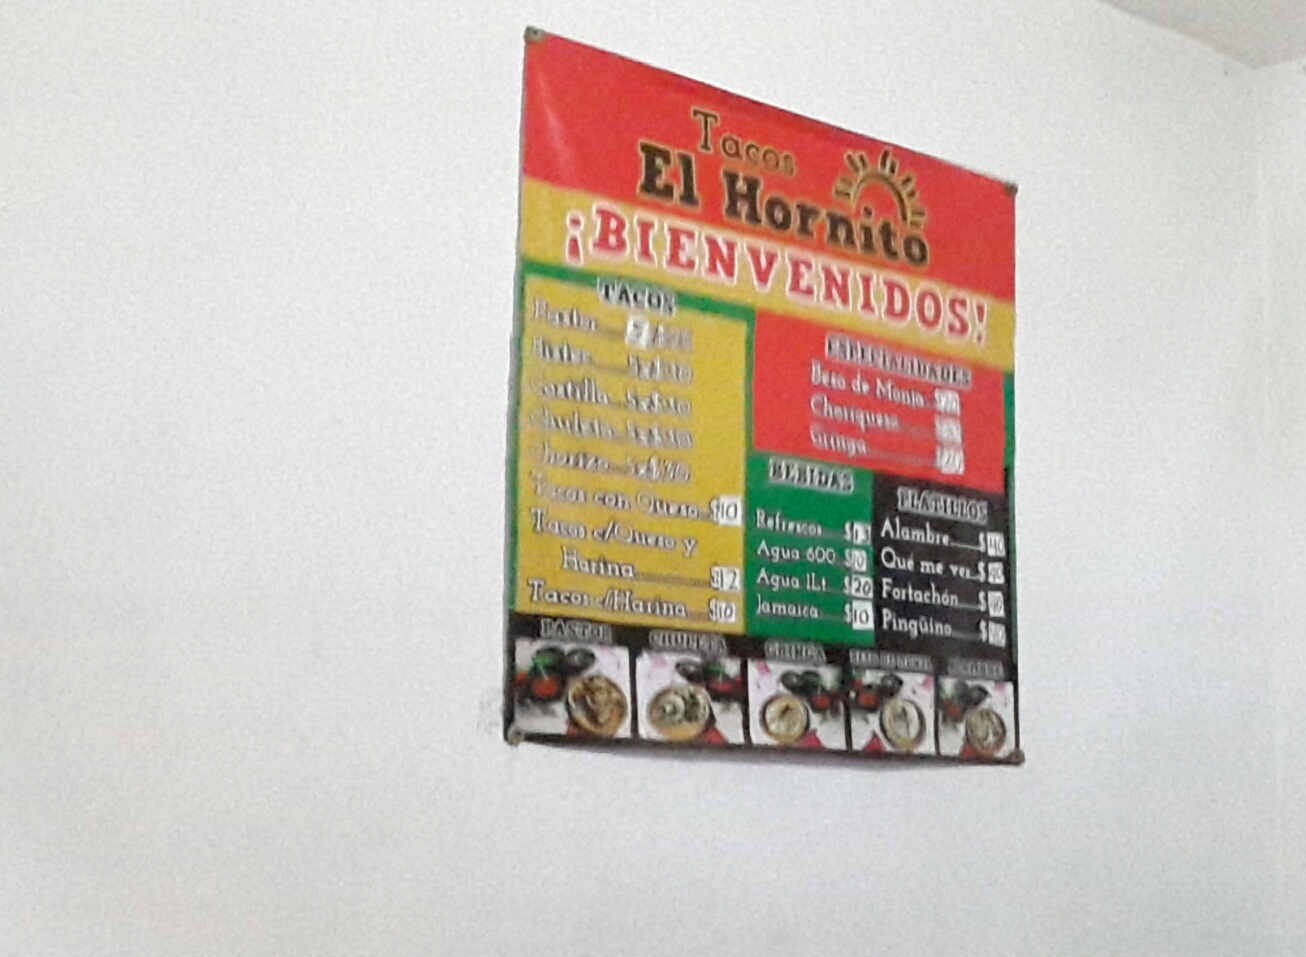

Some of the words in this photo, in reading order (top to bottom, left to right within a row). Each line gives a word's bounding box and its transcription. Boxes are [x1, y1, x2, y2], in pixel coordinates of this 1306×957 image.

[692, 107, 796, 175] Tacos
[638, 142, 700, 208] El
[721, 167, 930, 266] Hornito
[565, 203, 988, 346] ¡BIENVENIDOS!
[598, 279, 676, 316] TACOS
[852, 369, 870, 395] de
[530, 470, 587, 502] Tacos
[594, 492, 631, 510] con
[637, 492, 700, 518] Queso
[530, 508, 587, 539] Tacos
[683, 538, 698, 558] y
[756, 508, 823, 537] Refrescos
[881, 516, 950, 546] Alambre
[561, 546, 636, 578] Harina
[757, 540, 800, 563] Agua
[806, 549, 836, 564] 600
[881, 547, 915, 569] Qué
[920, 558, 943, 575] me
[528, 579, 591, 606] Tacos
[757, 568, 800, 591] Agua
[844, 576, 873, 598] $20
[882, 578, 959, 607] Fortachón
[757, 594, 819, 618] Jamaica
[845, 602, 871, 625] $10
